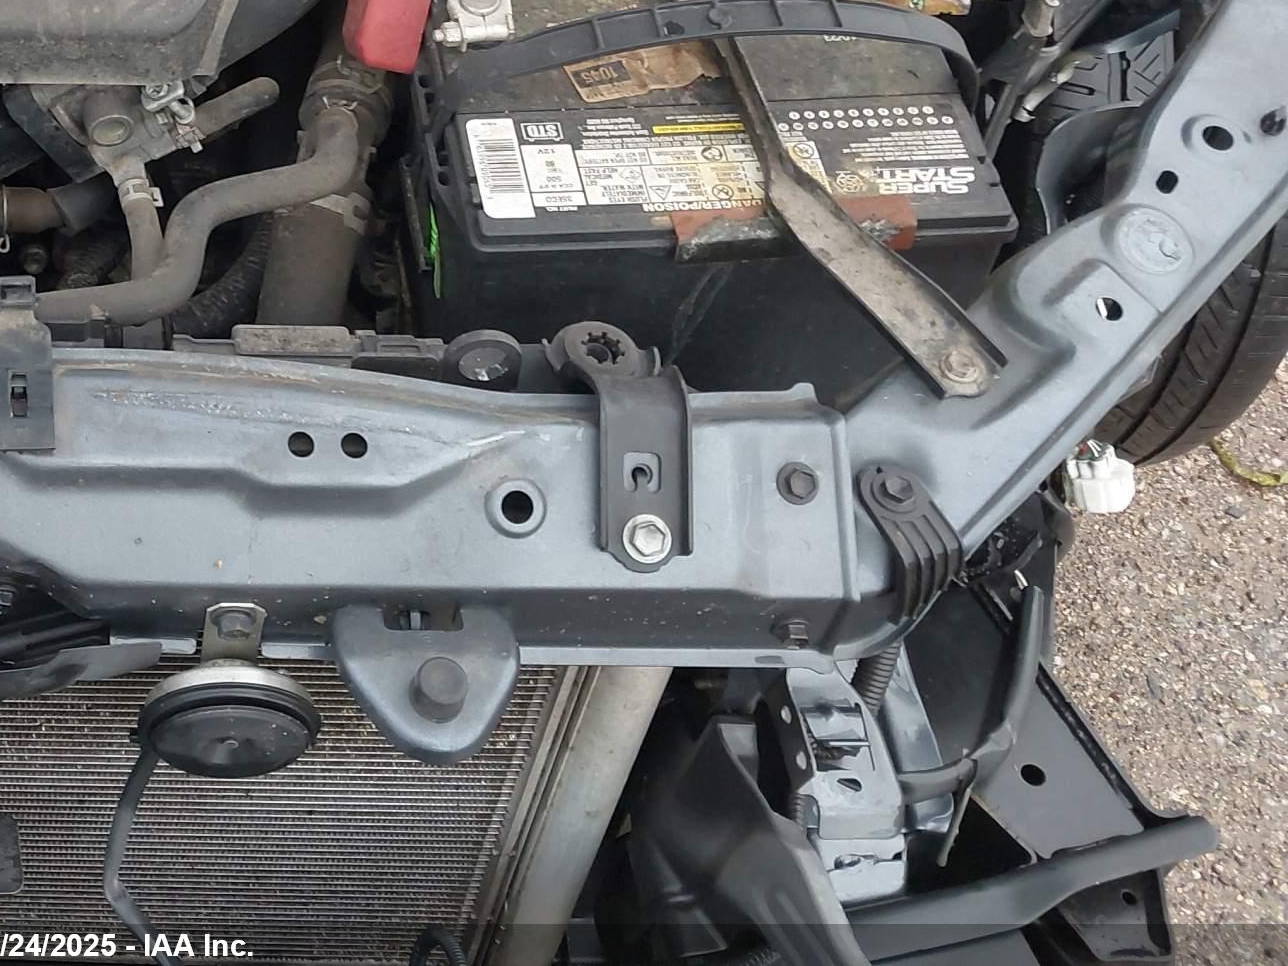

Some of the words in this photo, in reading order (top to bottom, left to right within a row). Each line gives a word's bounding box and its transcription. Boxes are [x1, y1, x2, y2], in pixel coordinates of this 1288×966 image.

[579, 65, 619, 84] 1045
[526, 124, 559, 138] STD
[876, 169, 976, 183] START
[878, 181, 970, 195] SUPER
[642, 199, 762, 212] DANGER/POISON
